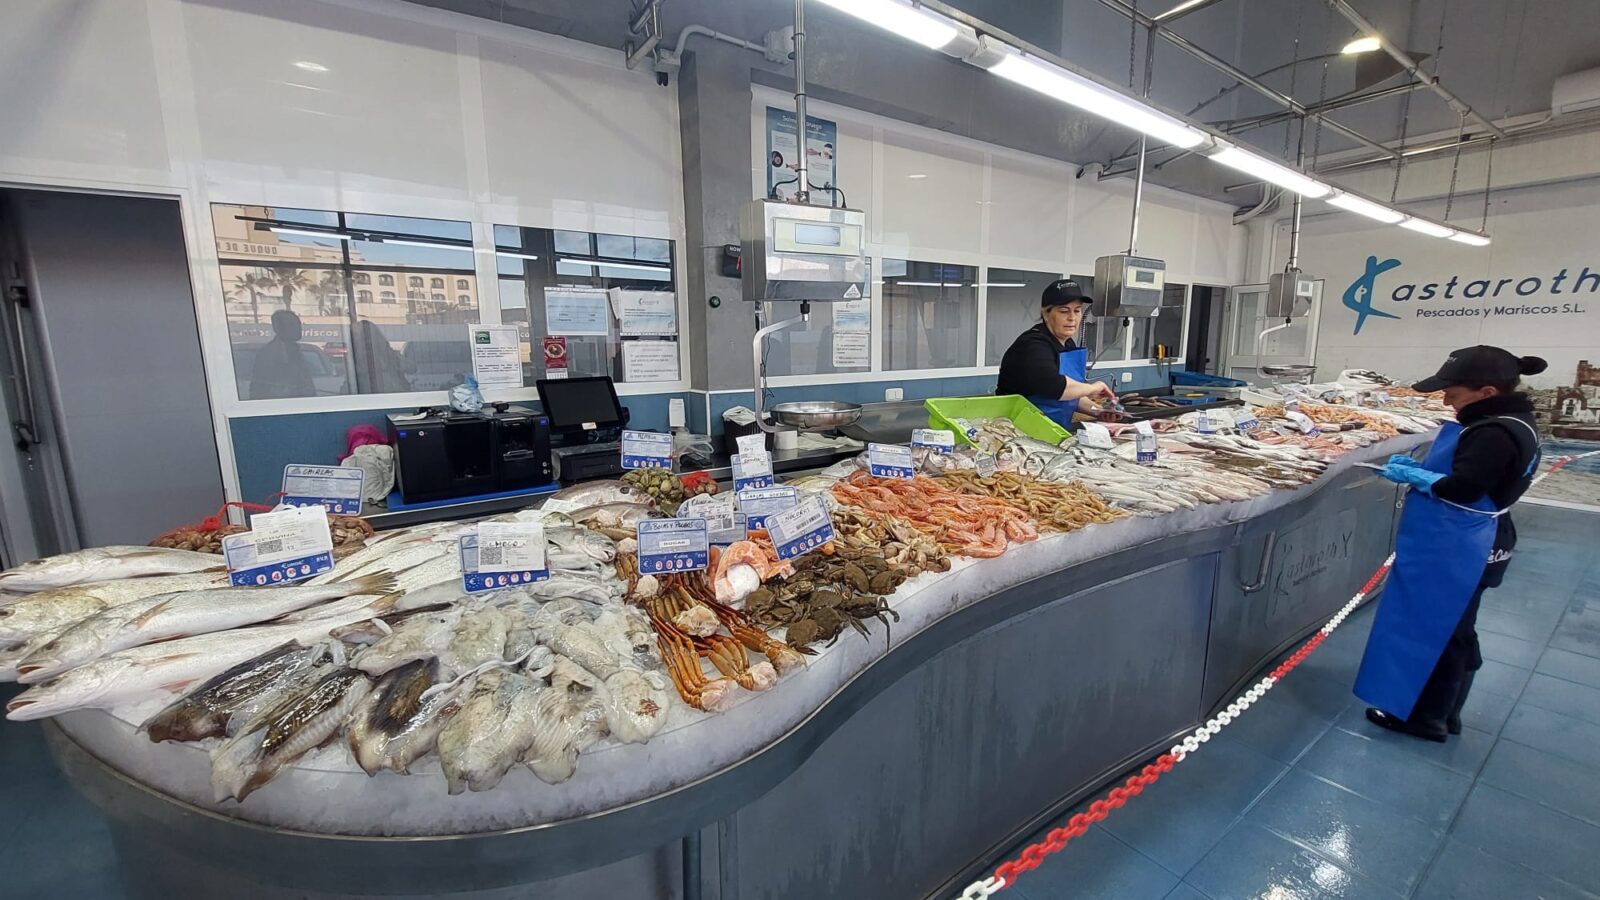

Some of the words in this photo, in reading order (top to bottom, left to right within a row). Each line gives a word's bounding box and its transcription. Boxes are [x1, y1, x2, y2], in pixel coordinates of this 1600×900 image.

[1416, 307, 1479, 318] Pescados
[1484, 308, 1490, 319] y
[1494, 304, 1558, 317] Mariscos
[1561, 303, 1585, 314] S.L.
